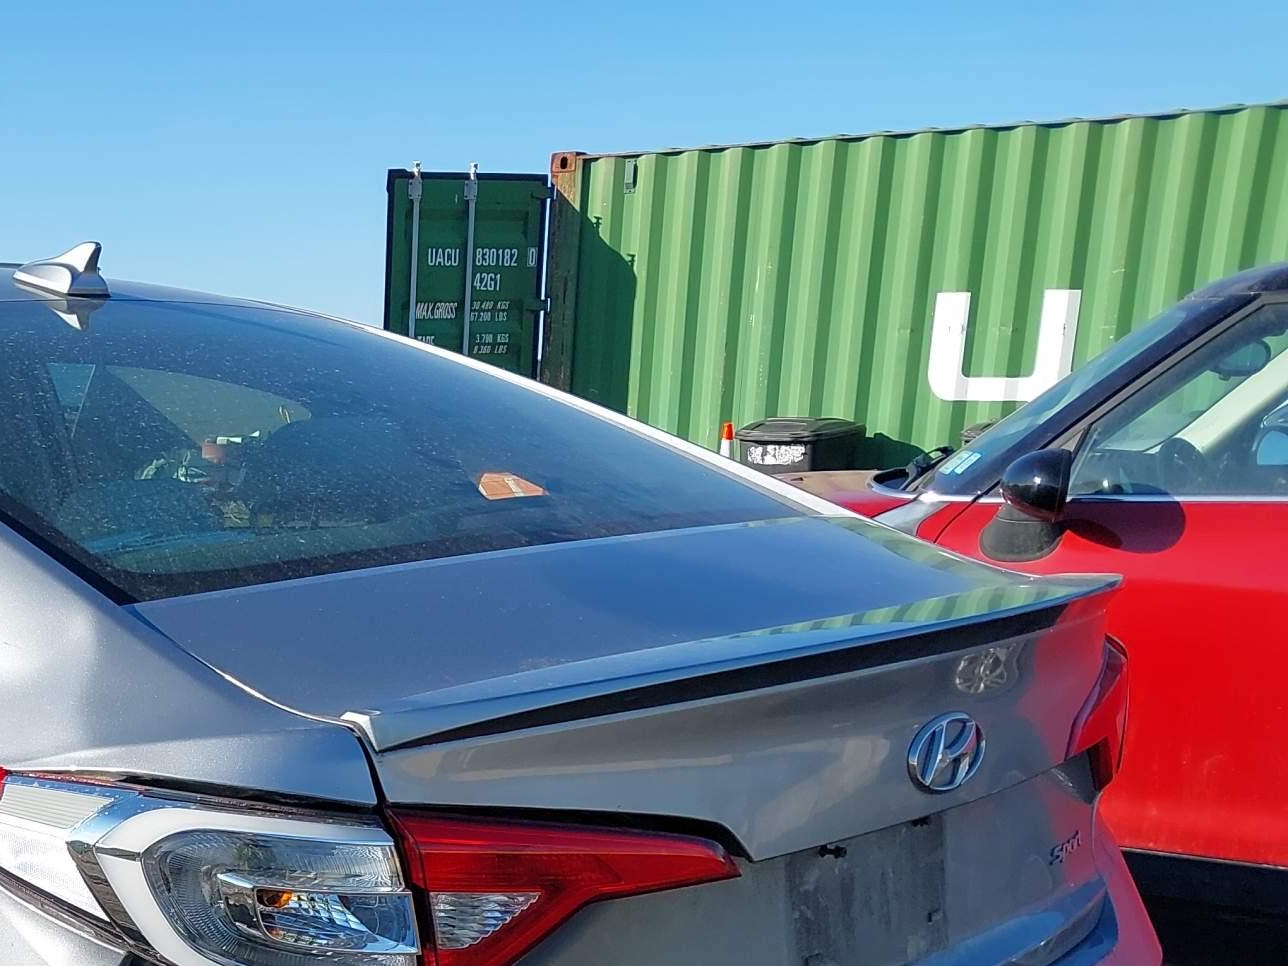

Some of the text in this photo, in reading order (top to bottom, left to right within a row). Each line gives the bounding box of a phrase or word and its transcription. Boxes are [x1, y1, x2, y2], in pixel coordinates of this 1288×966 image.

[428, 249, 459, 266] UACU
[475, 248, 518, 266] 830182
[473, 273, 501, 291] 42G1
[928, 289, 1082, 402] U
